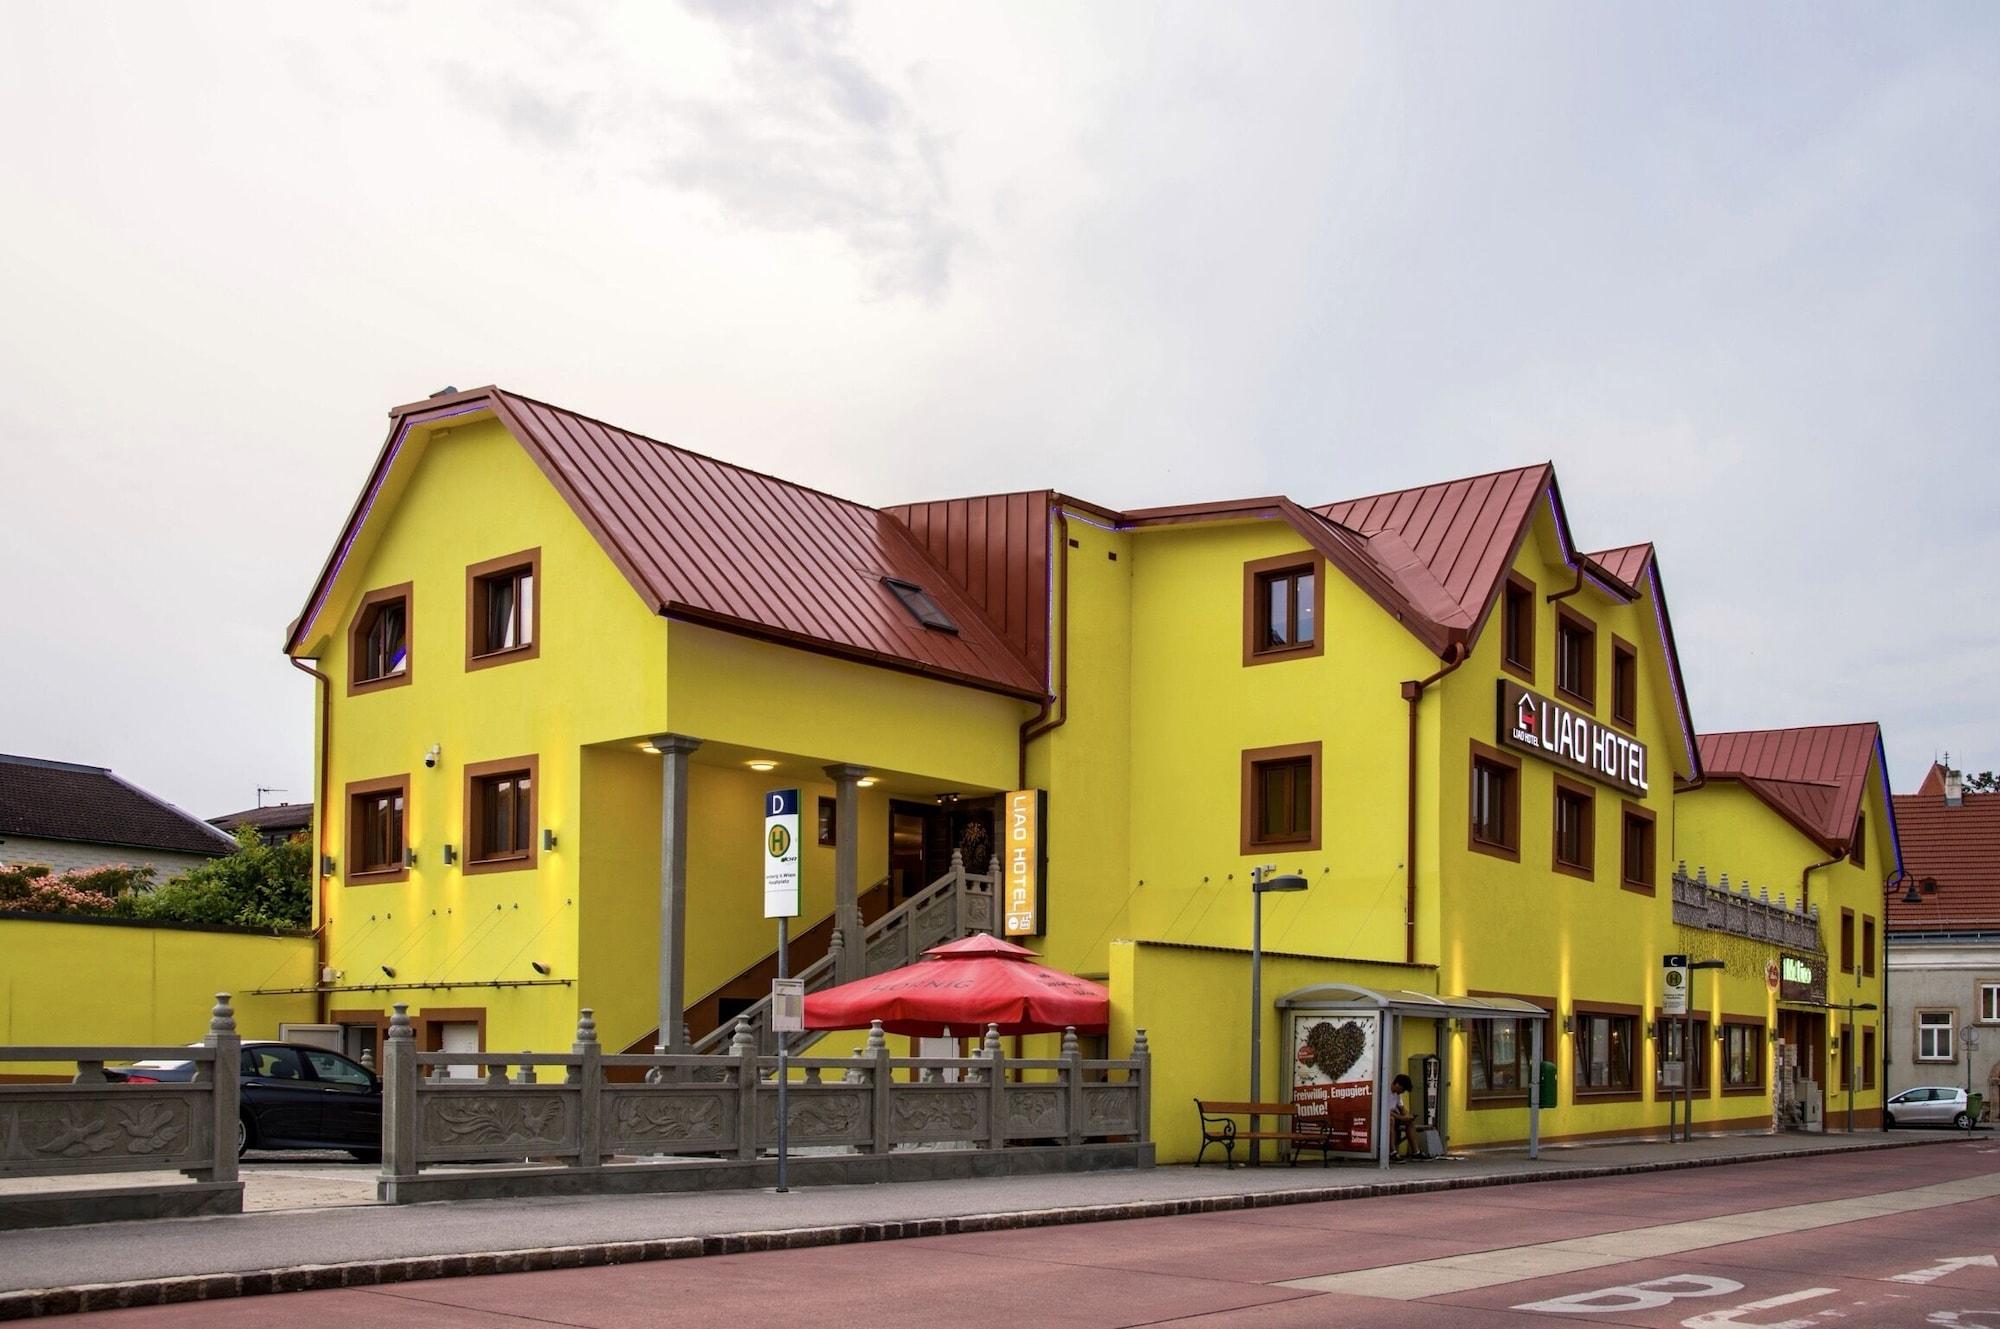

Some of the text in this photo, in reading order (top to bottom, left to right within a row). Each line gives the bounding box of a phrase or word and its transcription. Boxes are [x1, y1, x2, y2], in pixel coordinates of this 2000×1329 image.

[1513, 728, 1540, 747] LIAO HOTEL
[1541, 701, 1649, 790] LIAO HOTEL
[772, 795, 784, 814] D
[772, 830, 784, 851] H
[1013, 796, 1026, 912] LIAO HOTEL
[1670, 956, 1679, 967] C
